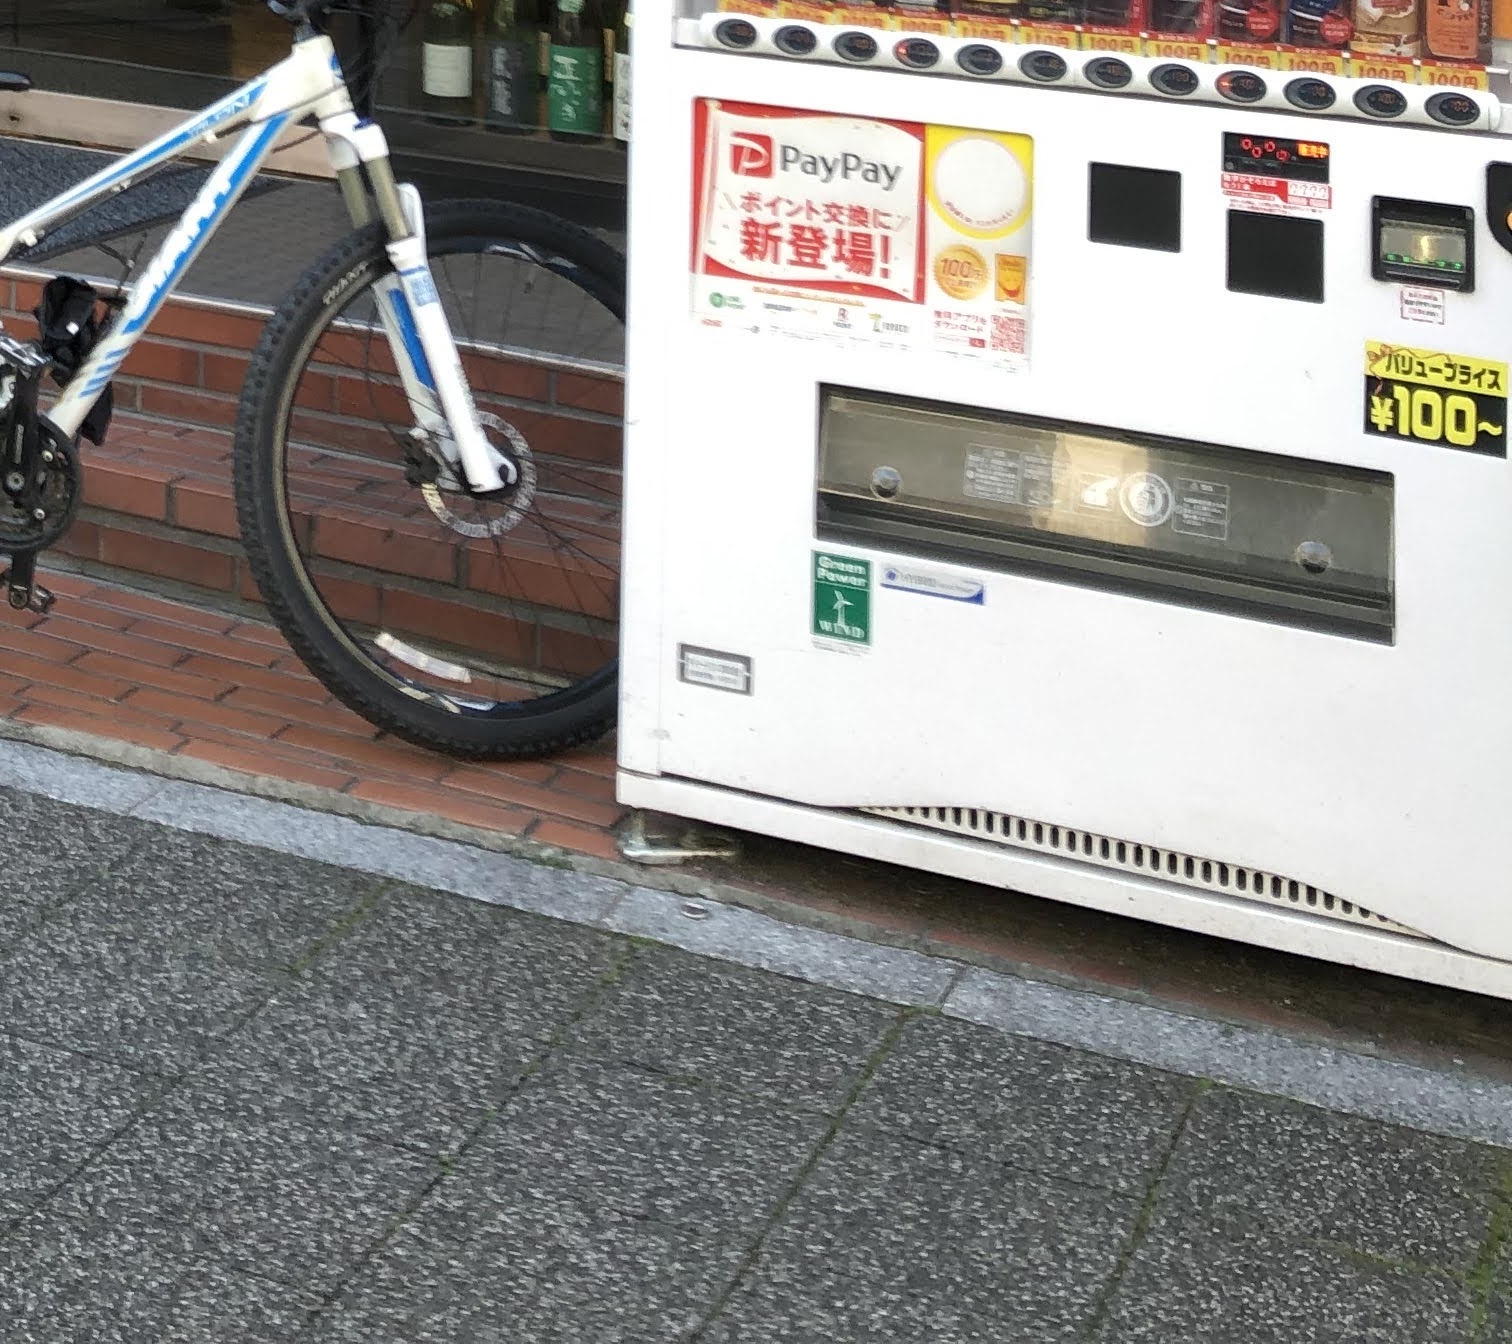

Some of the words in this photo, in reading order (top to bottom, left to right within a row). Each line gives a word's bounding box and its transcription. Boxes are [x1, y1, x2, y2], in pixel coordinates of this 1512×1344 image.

[779, 143, 903, 192] PayPay
[739, 190, 895, 230] ポイント交換に
[739, 217, 893, 280] 新登場!
[1384, 351, 1502, 391] バリュープライス
[816, 567, 869, 587] Power
[817, 555, 867, 575] Green
[818, 619, 866, 639] WIND
